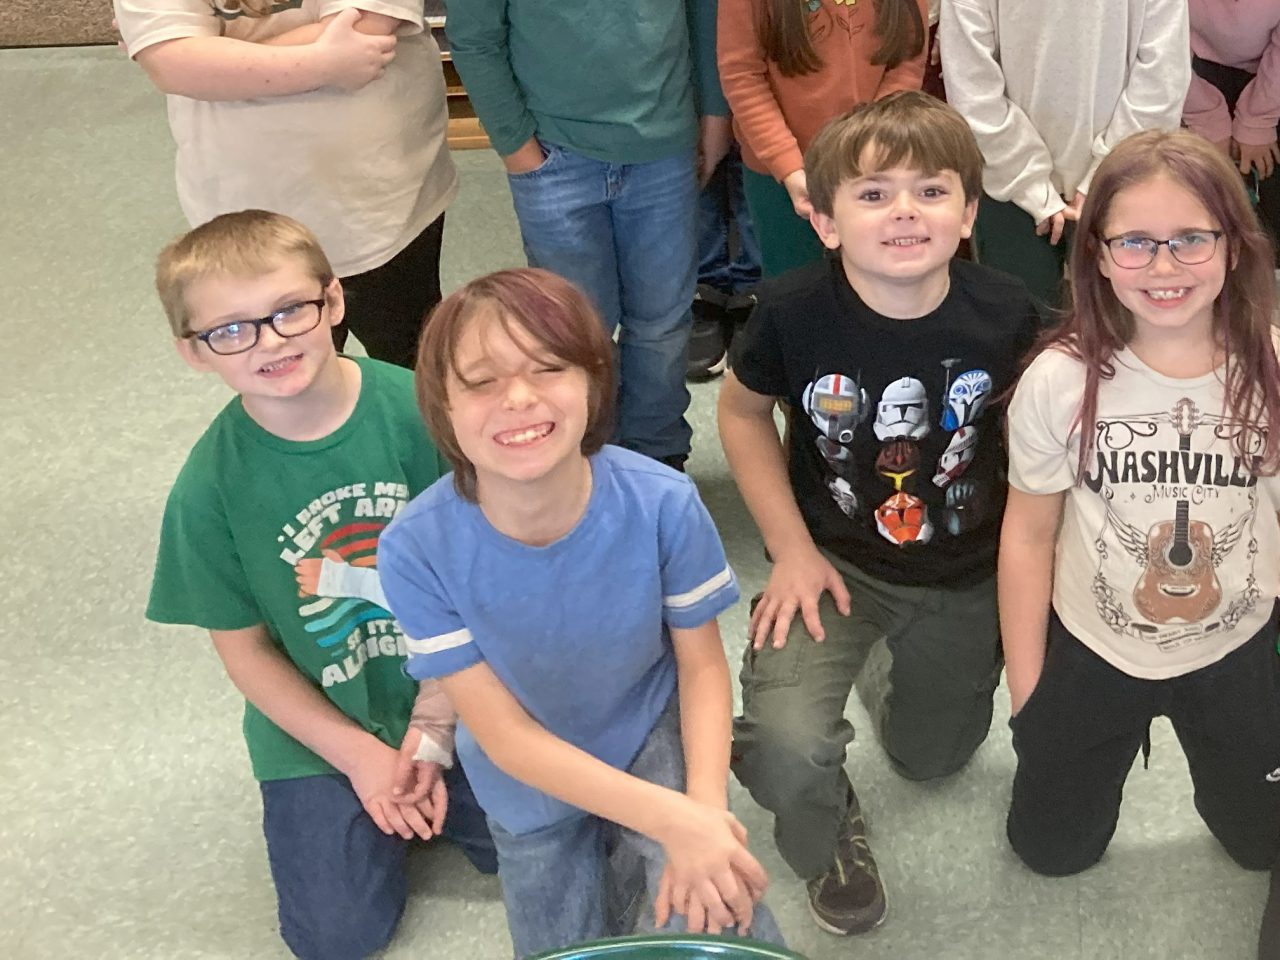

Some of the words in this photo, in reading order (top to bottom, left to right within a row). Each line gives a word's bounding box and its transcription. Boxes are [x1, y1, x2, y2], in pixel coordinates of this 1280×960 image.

[295, 483, 366, 526] BROKE
[374, 481, 410, 498] MY
[1144, 484, 1189, 504] MUSIC
[1192, 485, 1220, 505] CITY
[279, 502, 342, 566] LEFT
